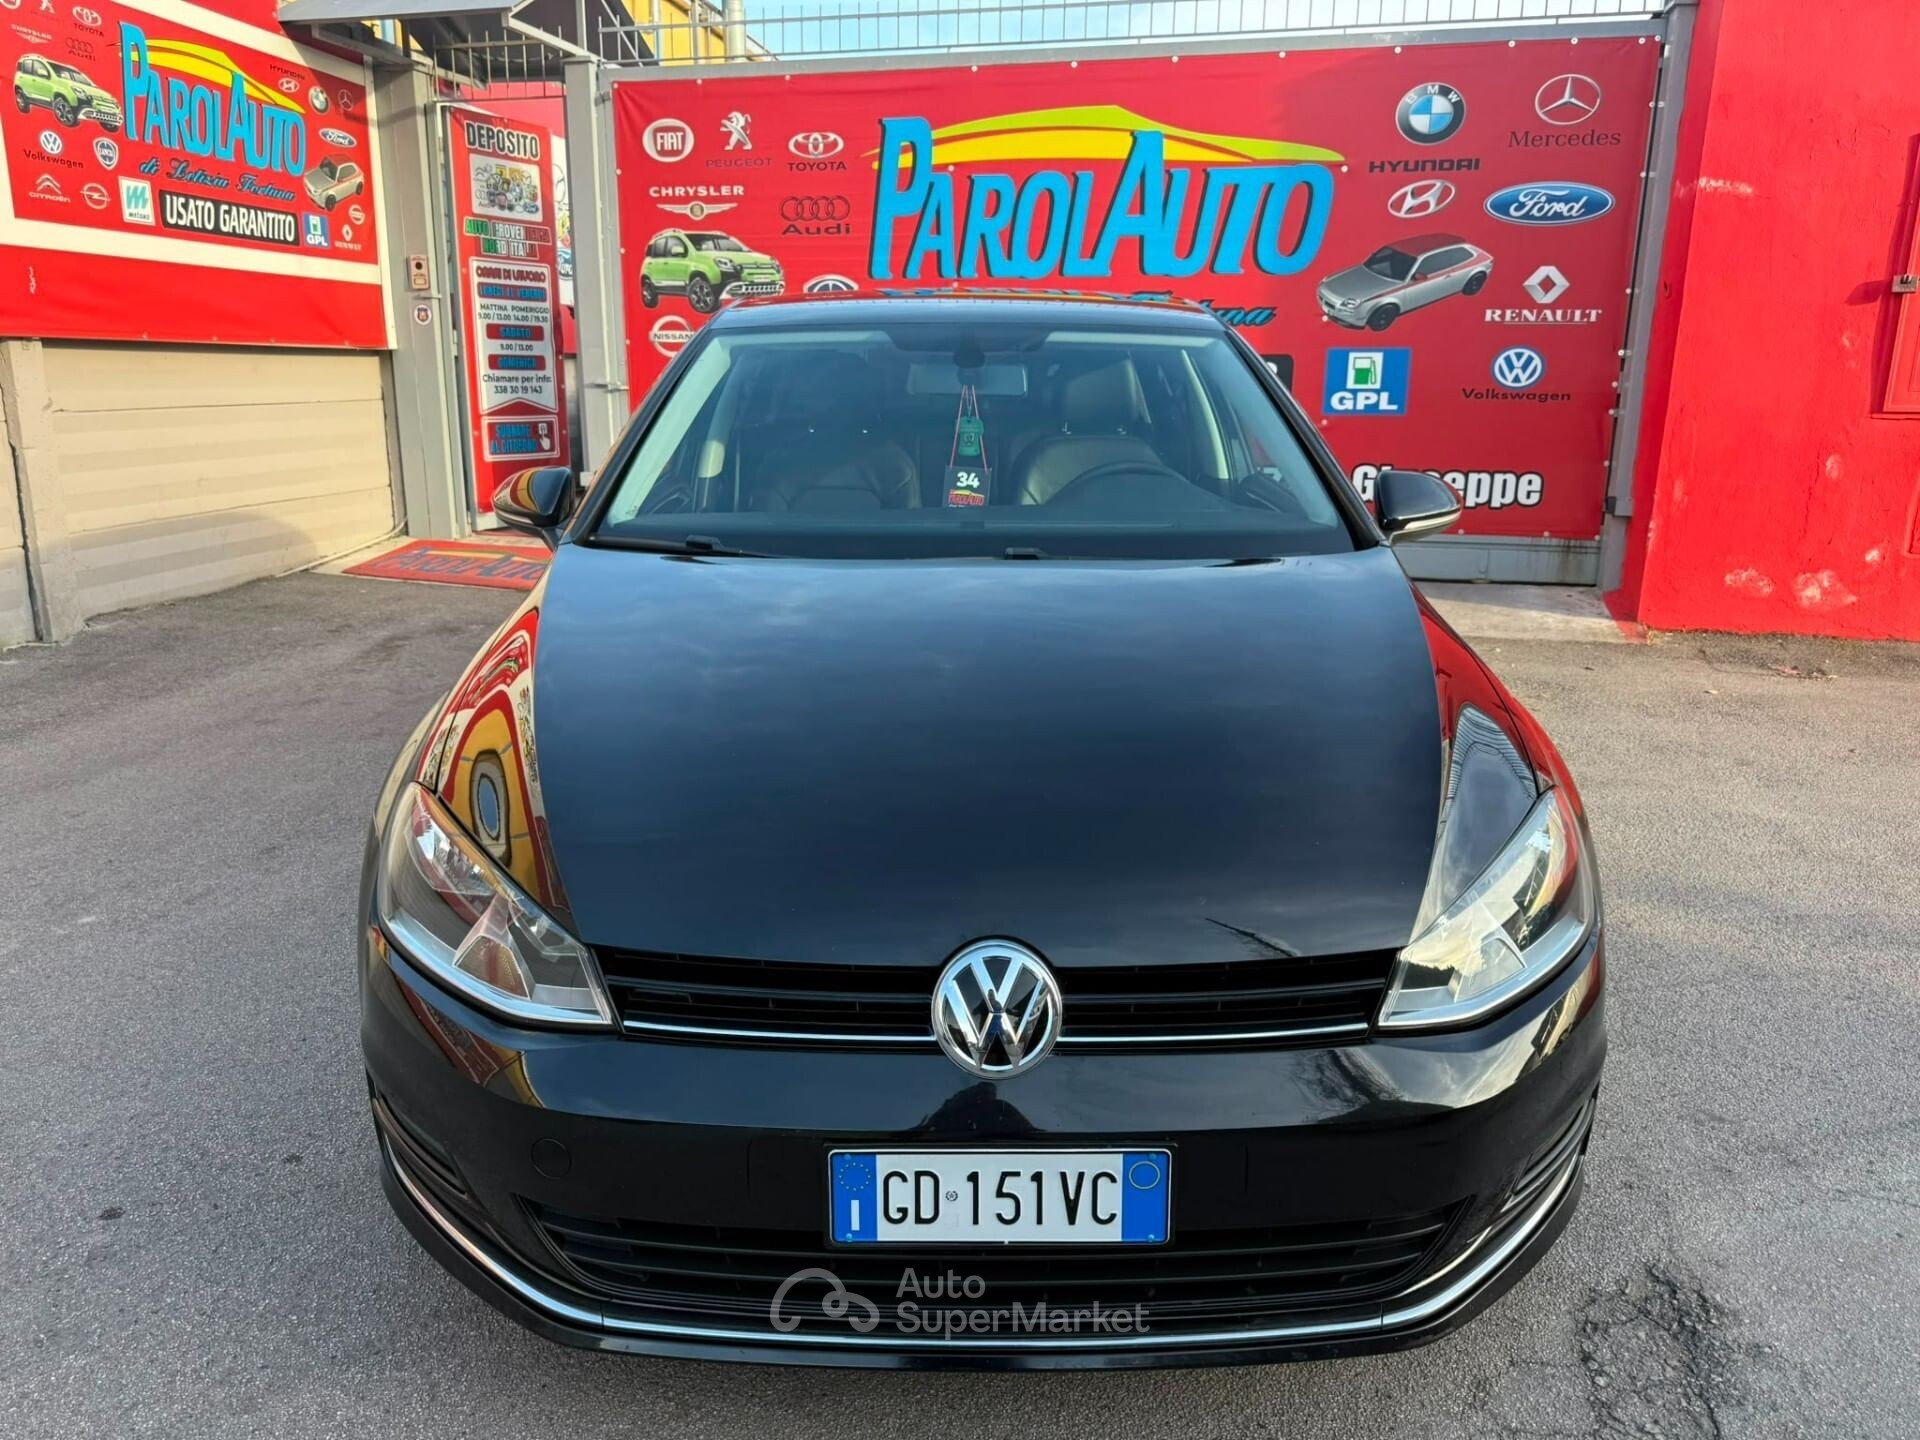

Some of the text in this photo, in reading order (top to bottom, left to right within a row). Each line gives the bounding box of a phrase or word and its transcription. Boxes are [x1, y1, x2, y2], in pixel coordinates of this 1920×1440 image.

[465, 122, 539, 159] DEPOSITO
[656, 131, 684, 151] FIAT
[1508, 129, 1622, 149] Mercedes
[24, 149, 84, 169] Volkswagen
[706, 157, 772, 169] PEUGEOT
[787, 161, 847, 172] TOYOTA
[1368, 158, 1481, 174] HYUNDAI
[649, 185, 745, 198] CHRYSLER
[1508, 189, 1588, 218] Ford
[164, 194, 296, 242] USATO GARANTITO
[781, 223, 851, 236] Audi
[306, 234, 328, 247] GPL
[480, 304, 508, 312] MATTINA
[1484, 308, 1603, 323] RENAULT
[482, 373, 520, 383] Chiamare
[521, 375, 534, 384] per
[494, 385, 542, 394] 338 30 19 143
[1461, 387, 1571, 402] Volkswagen
[1330, 391, 1399, 411] GPL
[956, 471, 980, 488] 34
[882, 1170, 1118, 1225] GD 151VC
